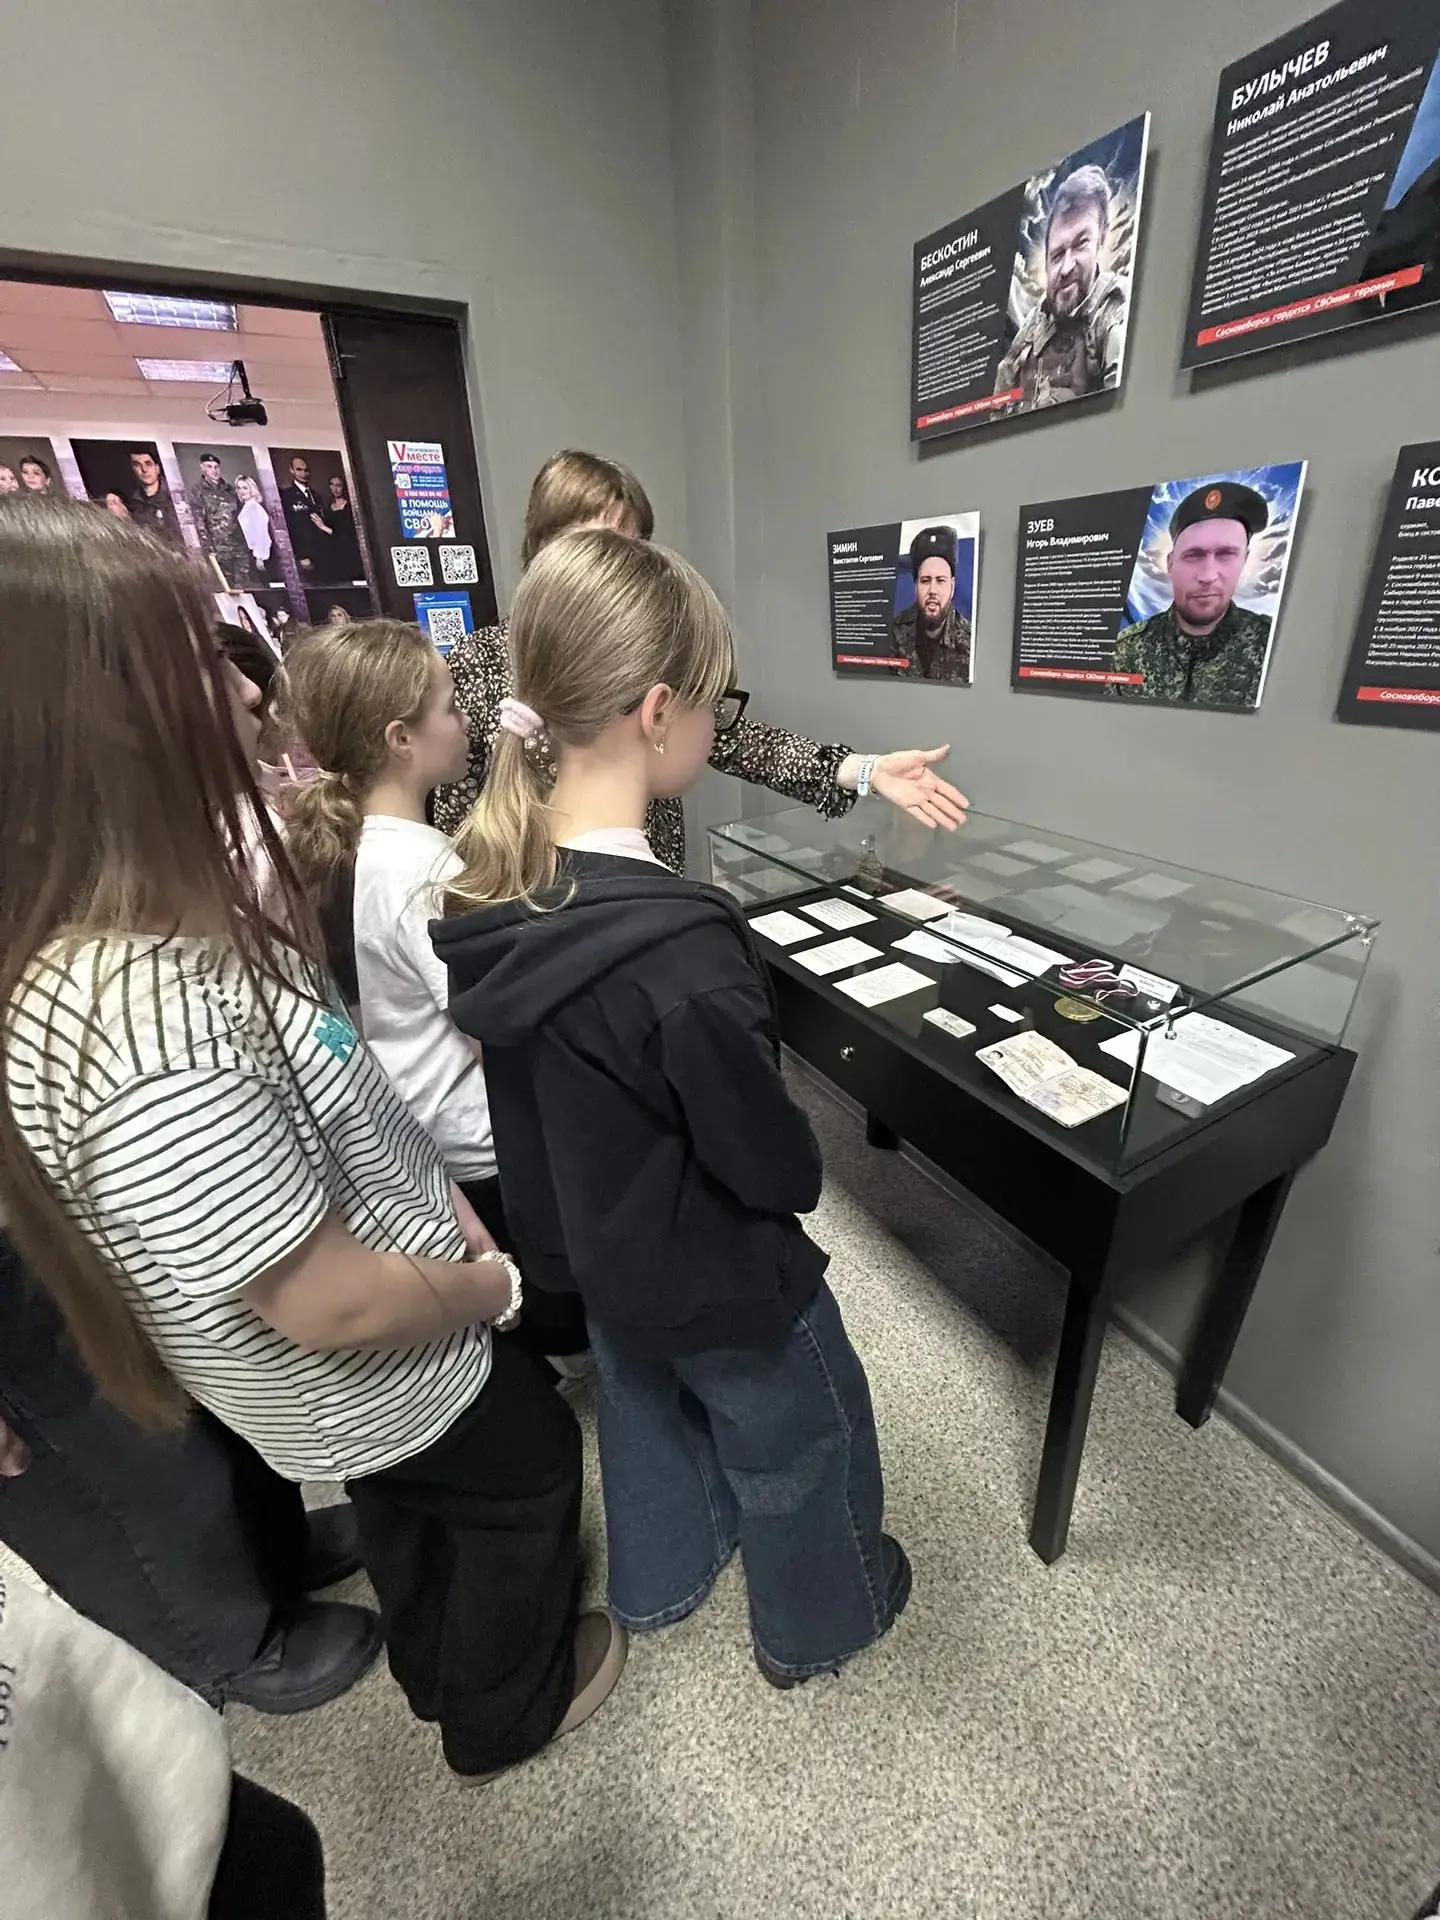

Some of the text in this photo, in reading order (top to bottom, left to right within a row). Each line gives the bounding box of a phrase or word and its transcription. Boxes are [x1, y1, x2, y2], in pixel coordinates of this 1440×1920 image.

[1231, 40, 1330, 111] БУЛЫЧЕВ
[1226, 93, 1285, 137] Николай
[1286, 44, 1388, 108] Анатольевич
[920, 228, 978, 272] БЕСКОСТИН
[955, 246, 992, 273] Сергеевич
[409, 499, 449, 510] ПОМОЩЬ
[404, 518, 429, 529] СВО
[1027, 518, 1055, 534] ЗУЕВ
[832, 541, 858, 554] ЗИМИН
[1026, 533, 1110, 549] Игорь Владимирович
